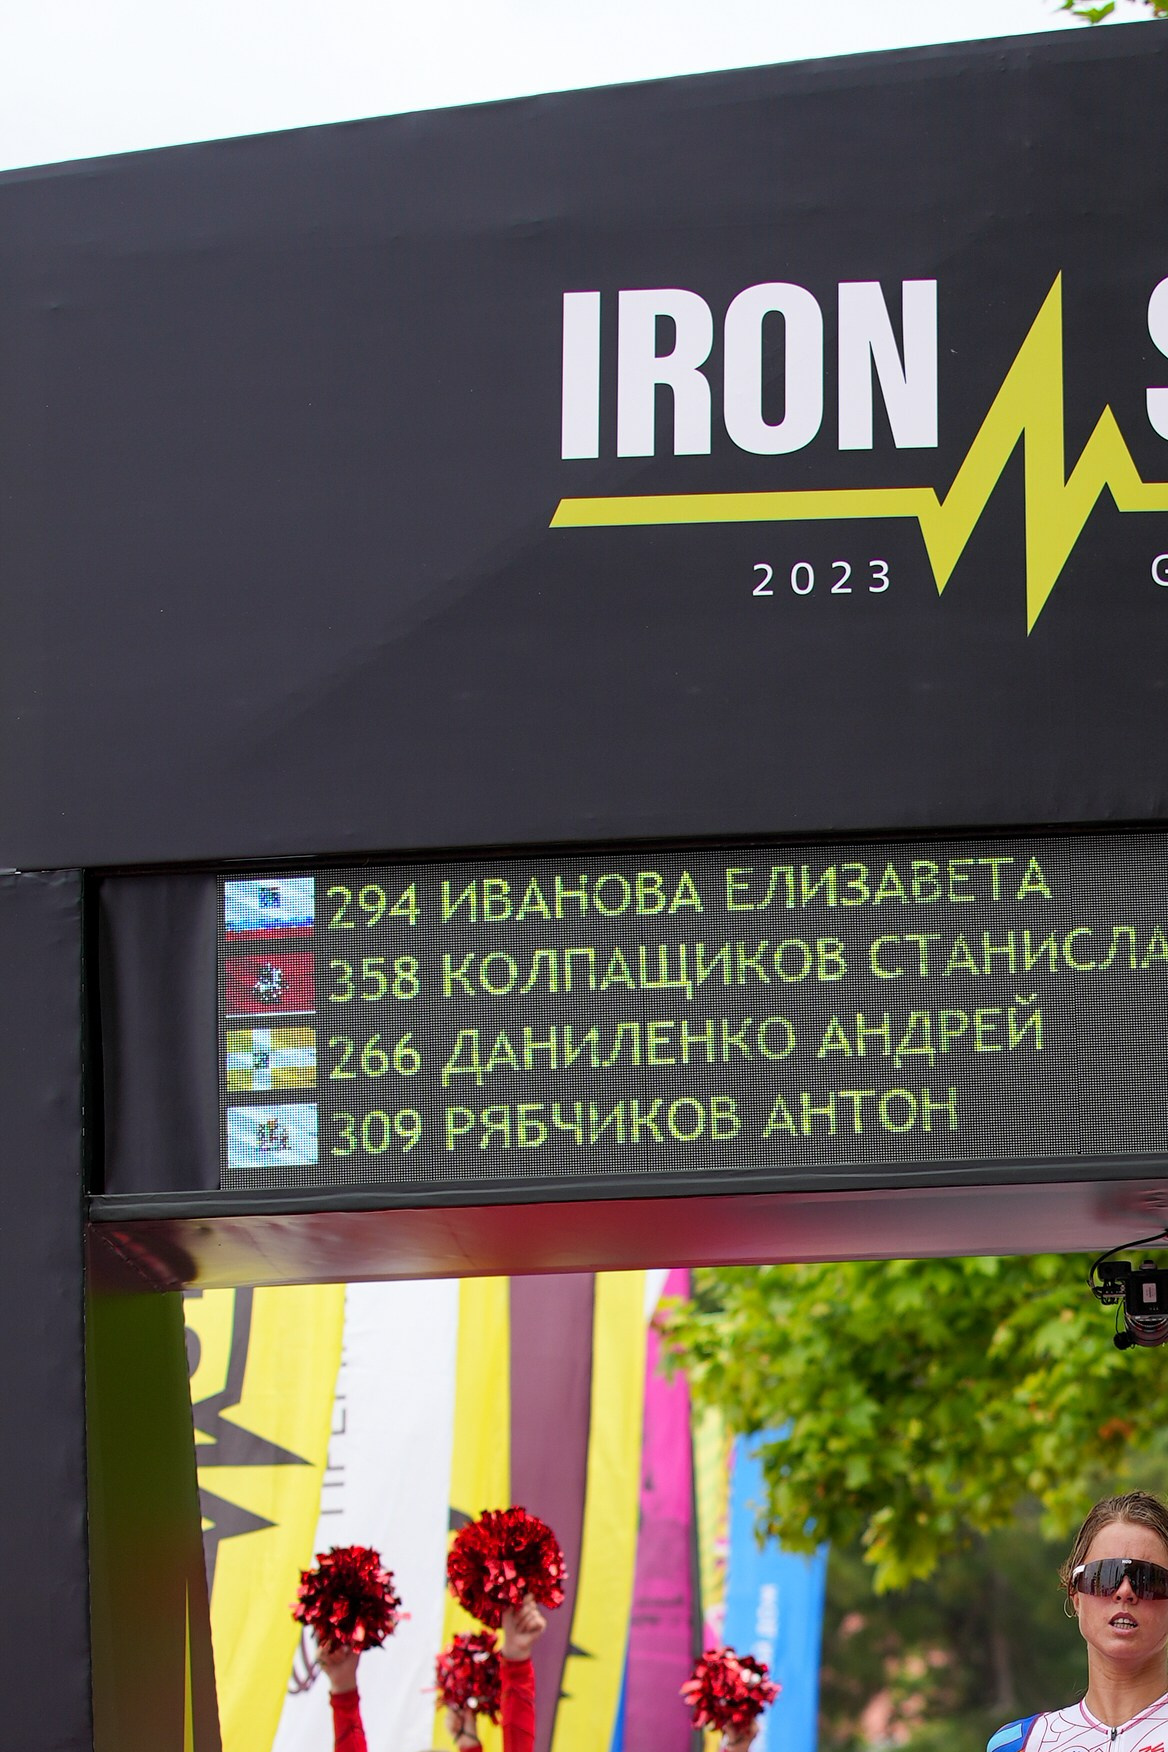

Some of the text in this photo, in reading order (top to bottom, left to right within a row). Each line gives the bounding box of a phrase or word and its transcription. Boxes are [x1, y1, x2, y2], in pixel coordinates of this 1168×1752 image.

[560, 277, 940, 460] IRON
[751, 558, 894, 597] 2023
[325, 882, 421, 931] 294
[440, 867, 703, 924] ИВАНОВА
[725, 856, 1054, 914] ЕЛИЗАВЕТА
[326, 955, 421, 1004] 358
[440, 936, 847, 1001] КОЛПАЩИКОВ
[327, 1031, 422, 1080] 266
[440, 1012, 797, 1087] ДАНИЛЕНКО
[817, 993, 1047, 1067] АНДРЕЙ
[329, 1107, 423, 1157] 309
[445, 1094, 742, 1152] РЯБЧИКОВ
[762, 1085, 960, 1138] АНТОН
